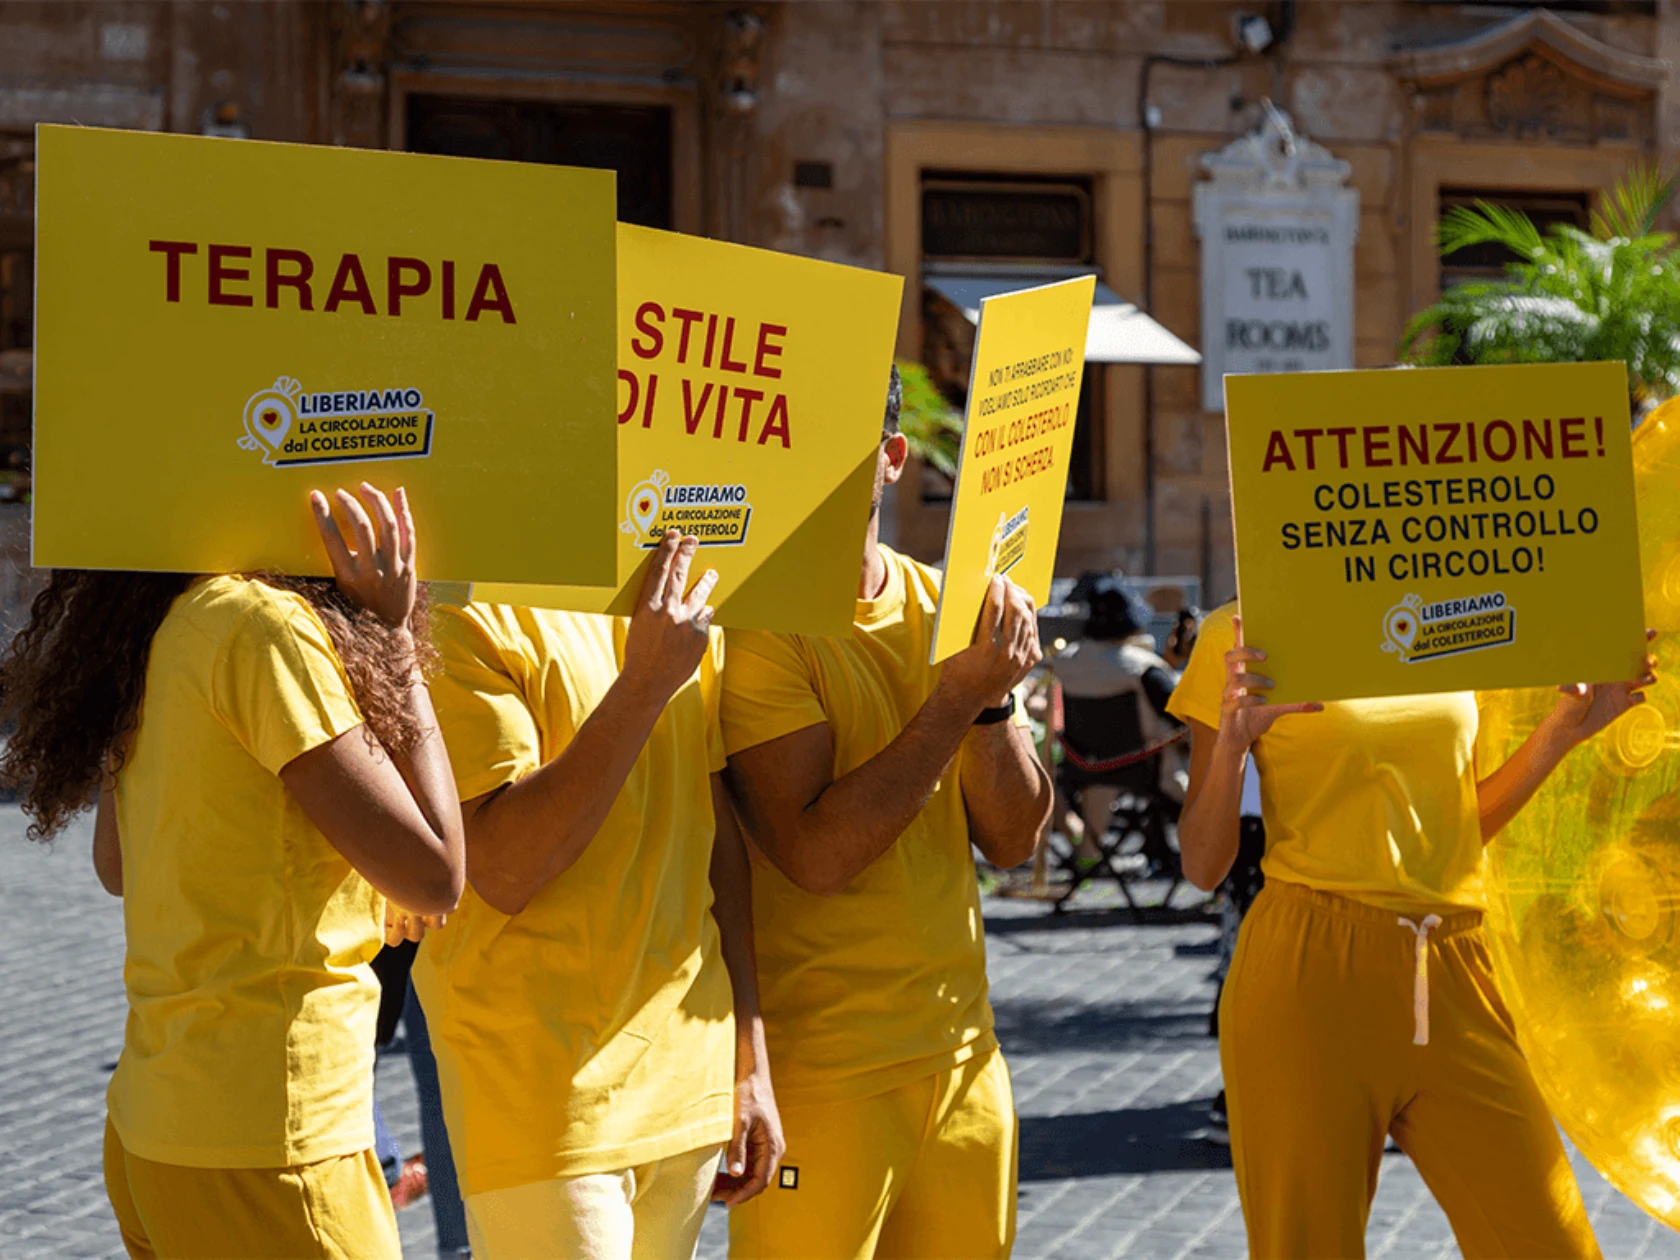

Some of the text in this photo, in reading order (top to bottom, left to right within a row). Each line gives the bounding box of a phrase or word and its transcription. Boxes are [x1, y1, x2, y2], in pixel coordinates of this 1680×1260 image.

[149, 240, 518, 324] TERAPIA
[1246, 267, 1309, 300] TEA
[631, 301, 788, 379] STILE
[1226, 318, 1330, 350] ROOMS
[988, 368, 1003, 388] NON
[301, 390, 421, 414] LIBERIAMO
[618, 369, 791, 449] DI VITA
[300, 416, 418, 434] LA CIRCOLAZIONE
[975, 402, 1070, 459] CON IL COLESTEROLO
[284, 433, 417, 454] dal COLESTEROLO
[1262, 417, 1606, 473] ATTENZIONE!
[980, 464, 1002, 496] NON
[1003, 459, 1014, 488] SI
[1314, 474, 1555, 511] COLESTEROLO
[665, 486, 746, 503] LIBERIAMO
[662, 508, 742, 521] LA CIRCOLAZIONE
[1281, 508, 1598, 550] SENZA CONTROLLO
[649, 525, 667, 537] dal
[1345, 547, 1545, 583] IN CIRCOLO!
[1422, 593, 1505, 621] LIBERIAMO
[1414, 626, 1505, 652] dal COLESTEROLO
[1423, 613, 1505, 636] LA CIRCOLAZIONE
